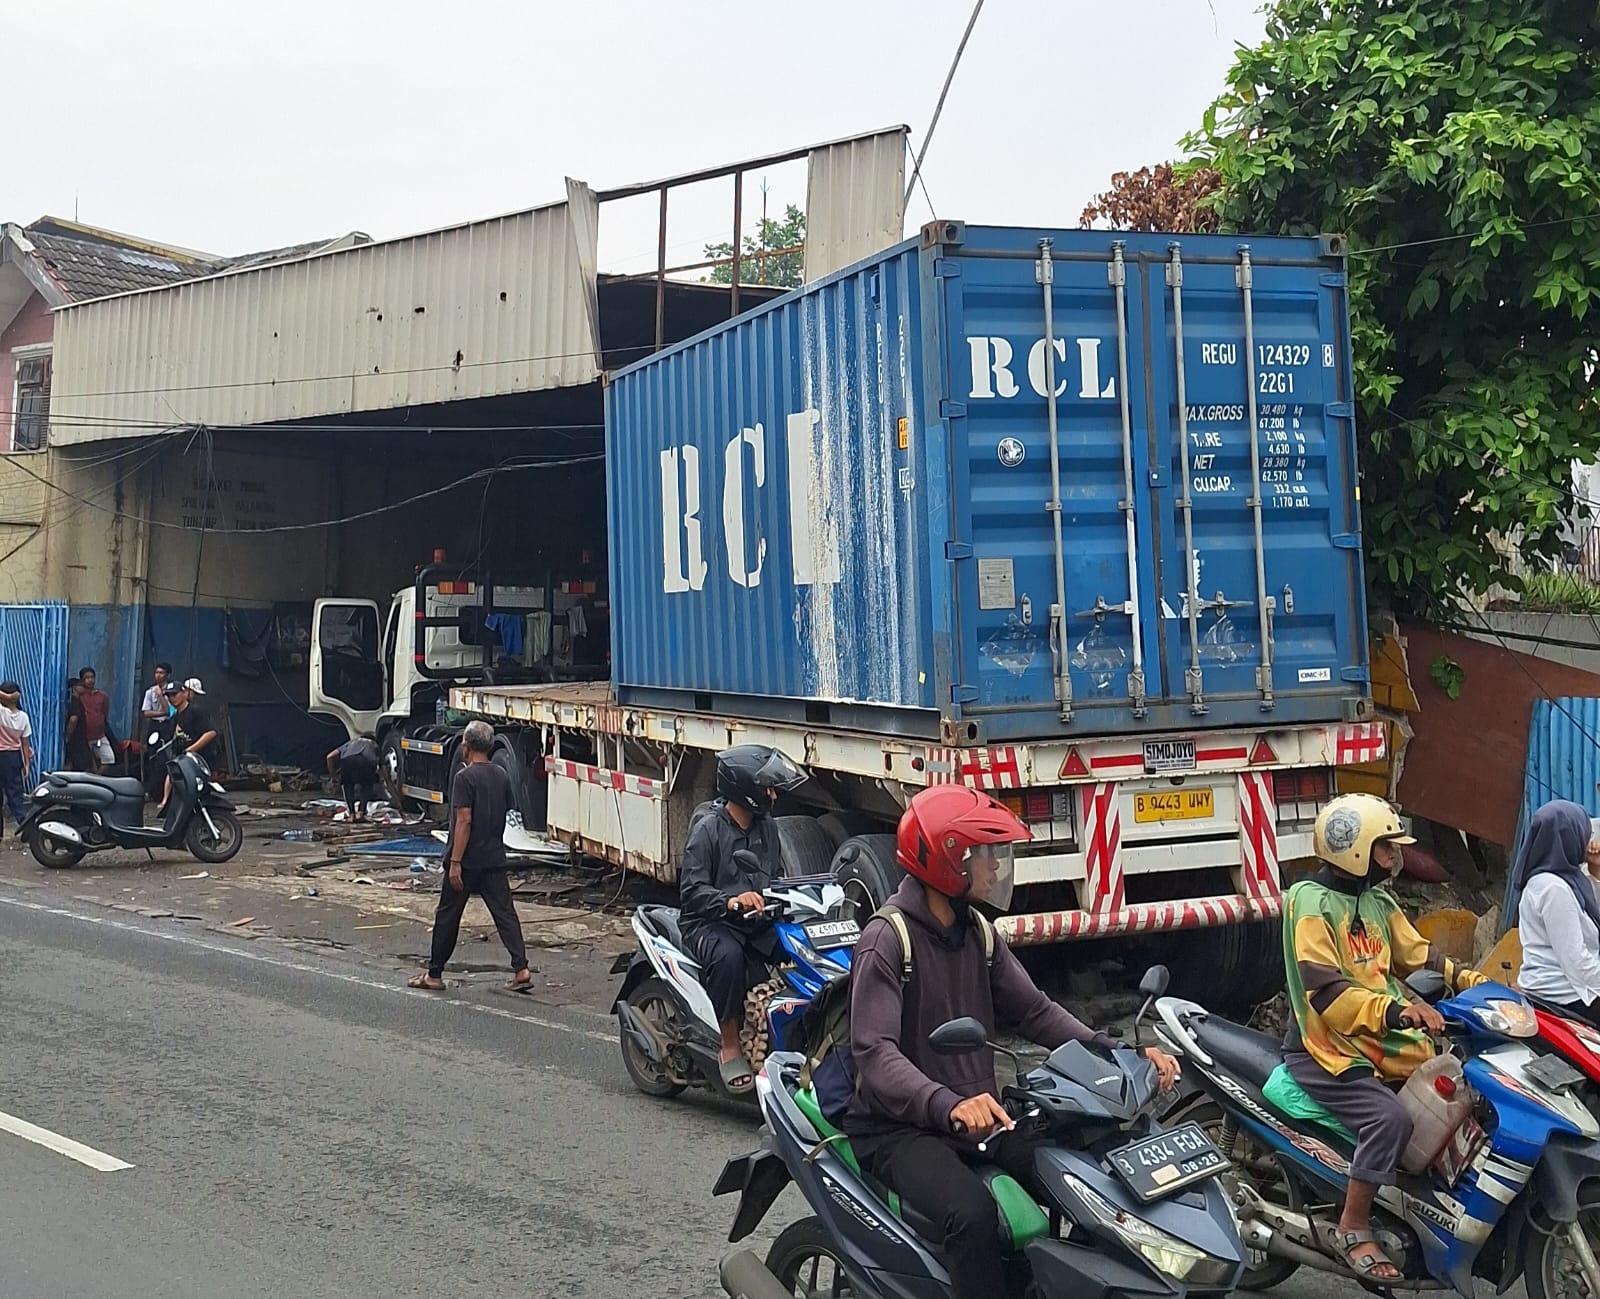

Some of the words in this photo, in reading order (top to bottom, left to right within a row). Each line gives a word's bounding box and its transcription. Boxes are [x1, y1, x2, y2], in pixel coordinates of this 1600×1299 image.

[1202, 343, 1236, 364] REGU
[1258, 345, 1310, 365] 124329
[1323, 345, 1333, 366] 8
[966, 336, 1115, 398] RCL
[1259, 373, 1294, 393] 22G1
[1260, 404, 1287, 416] 30.480
[1294, 404, 1303, 417] kg
[1259, 417, 1285, 429] 67.200
[1292, 418, 1300, 429] lb
[1298, 444, 1305, 455] lb
[1193, 454, 1216, 470] NET
[1262, 470, 1288, 482] 62.570
[1295, 471, 1303, 481] lb
[1146, 742, 1194, 760] SIMOJOYO
[1137, 797, 1145, 812] B
[1138, 1141, 1175, 1166] 4334
[1172, 1130, 1206, 1153] FGA
[1412, 1201, 1456, 1232] SUZUKI
